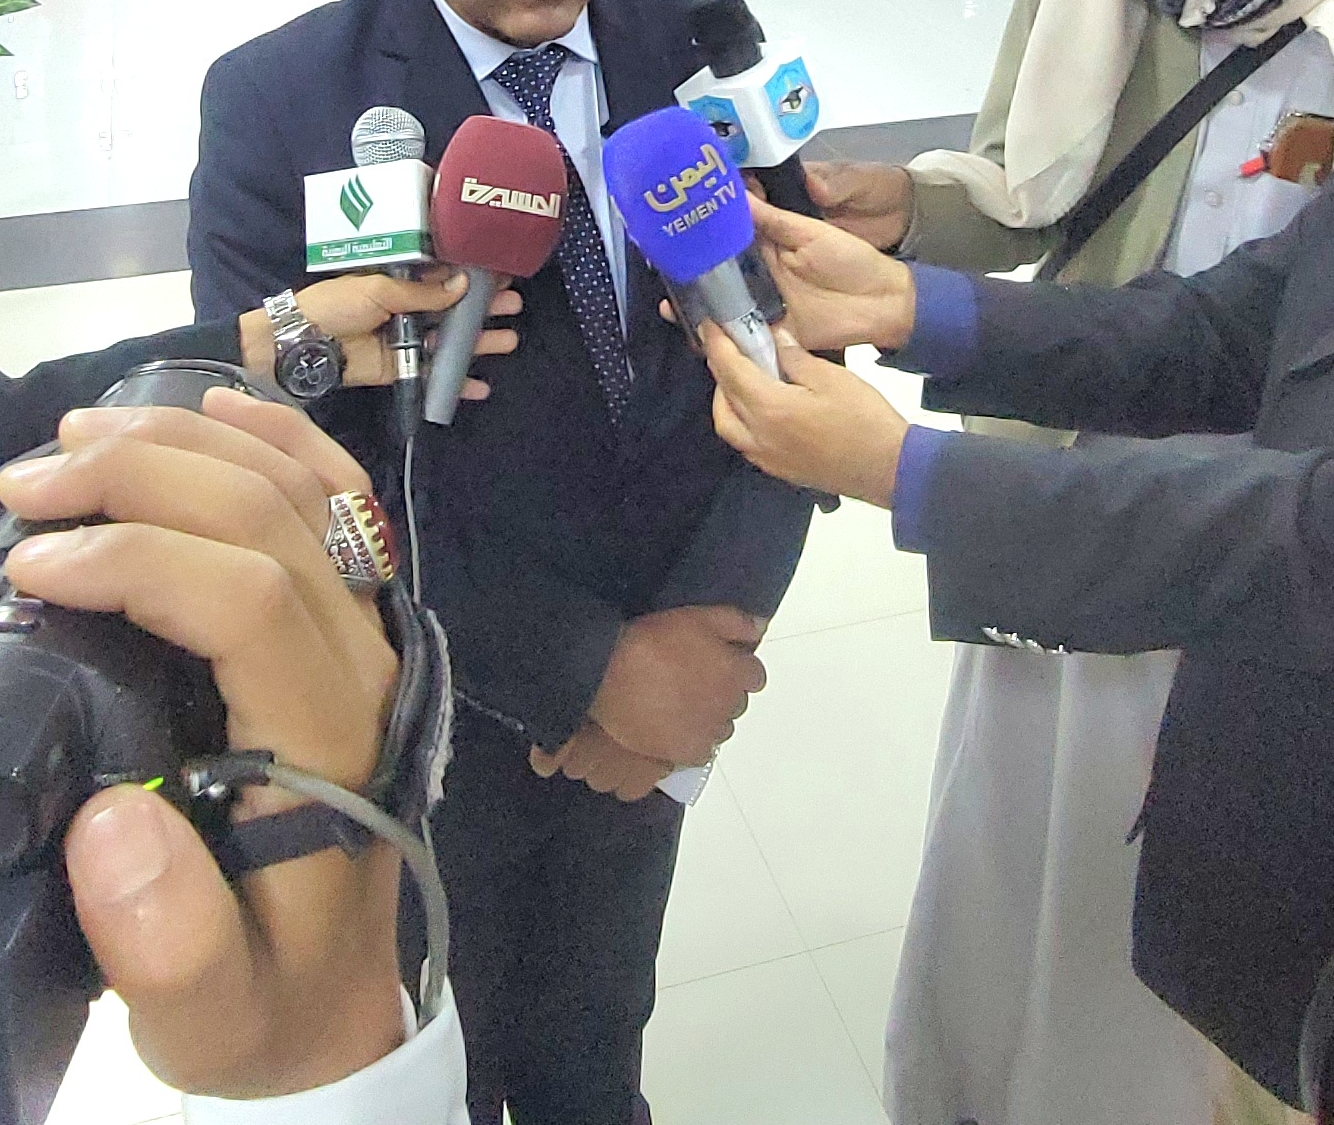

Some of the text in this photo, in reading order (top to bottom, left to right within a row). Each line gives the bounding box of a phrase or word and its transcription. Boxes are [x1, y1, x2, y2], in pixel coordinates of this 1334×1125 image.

[461, 177, 561, 219] المسيرة
[644, 143, 727, 212] اليمن
[662, 180, 736, 236] YEMEN TV
